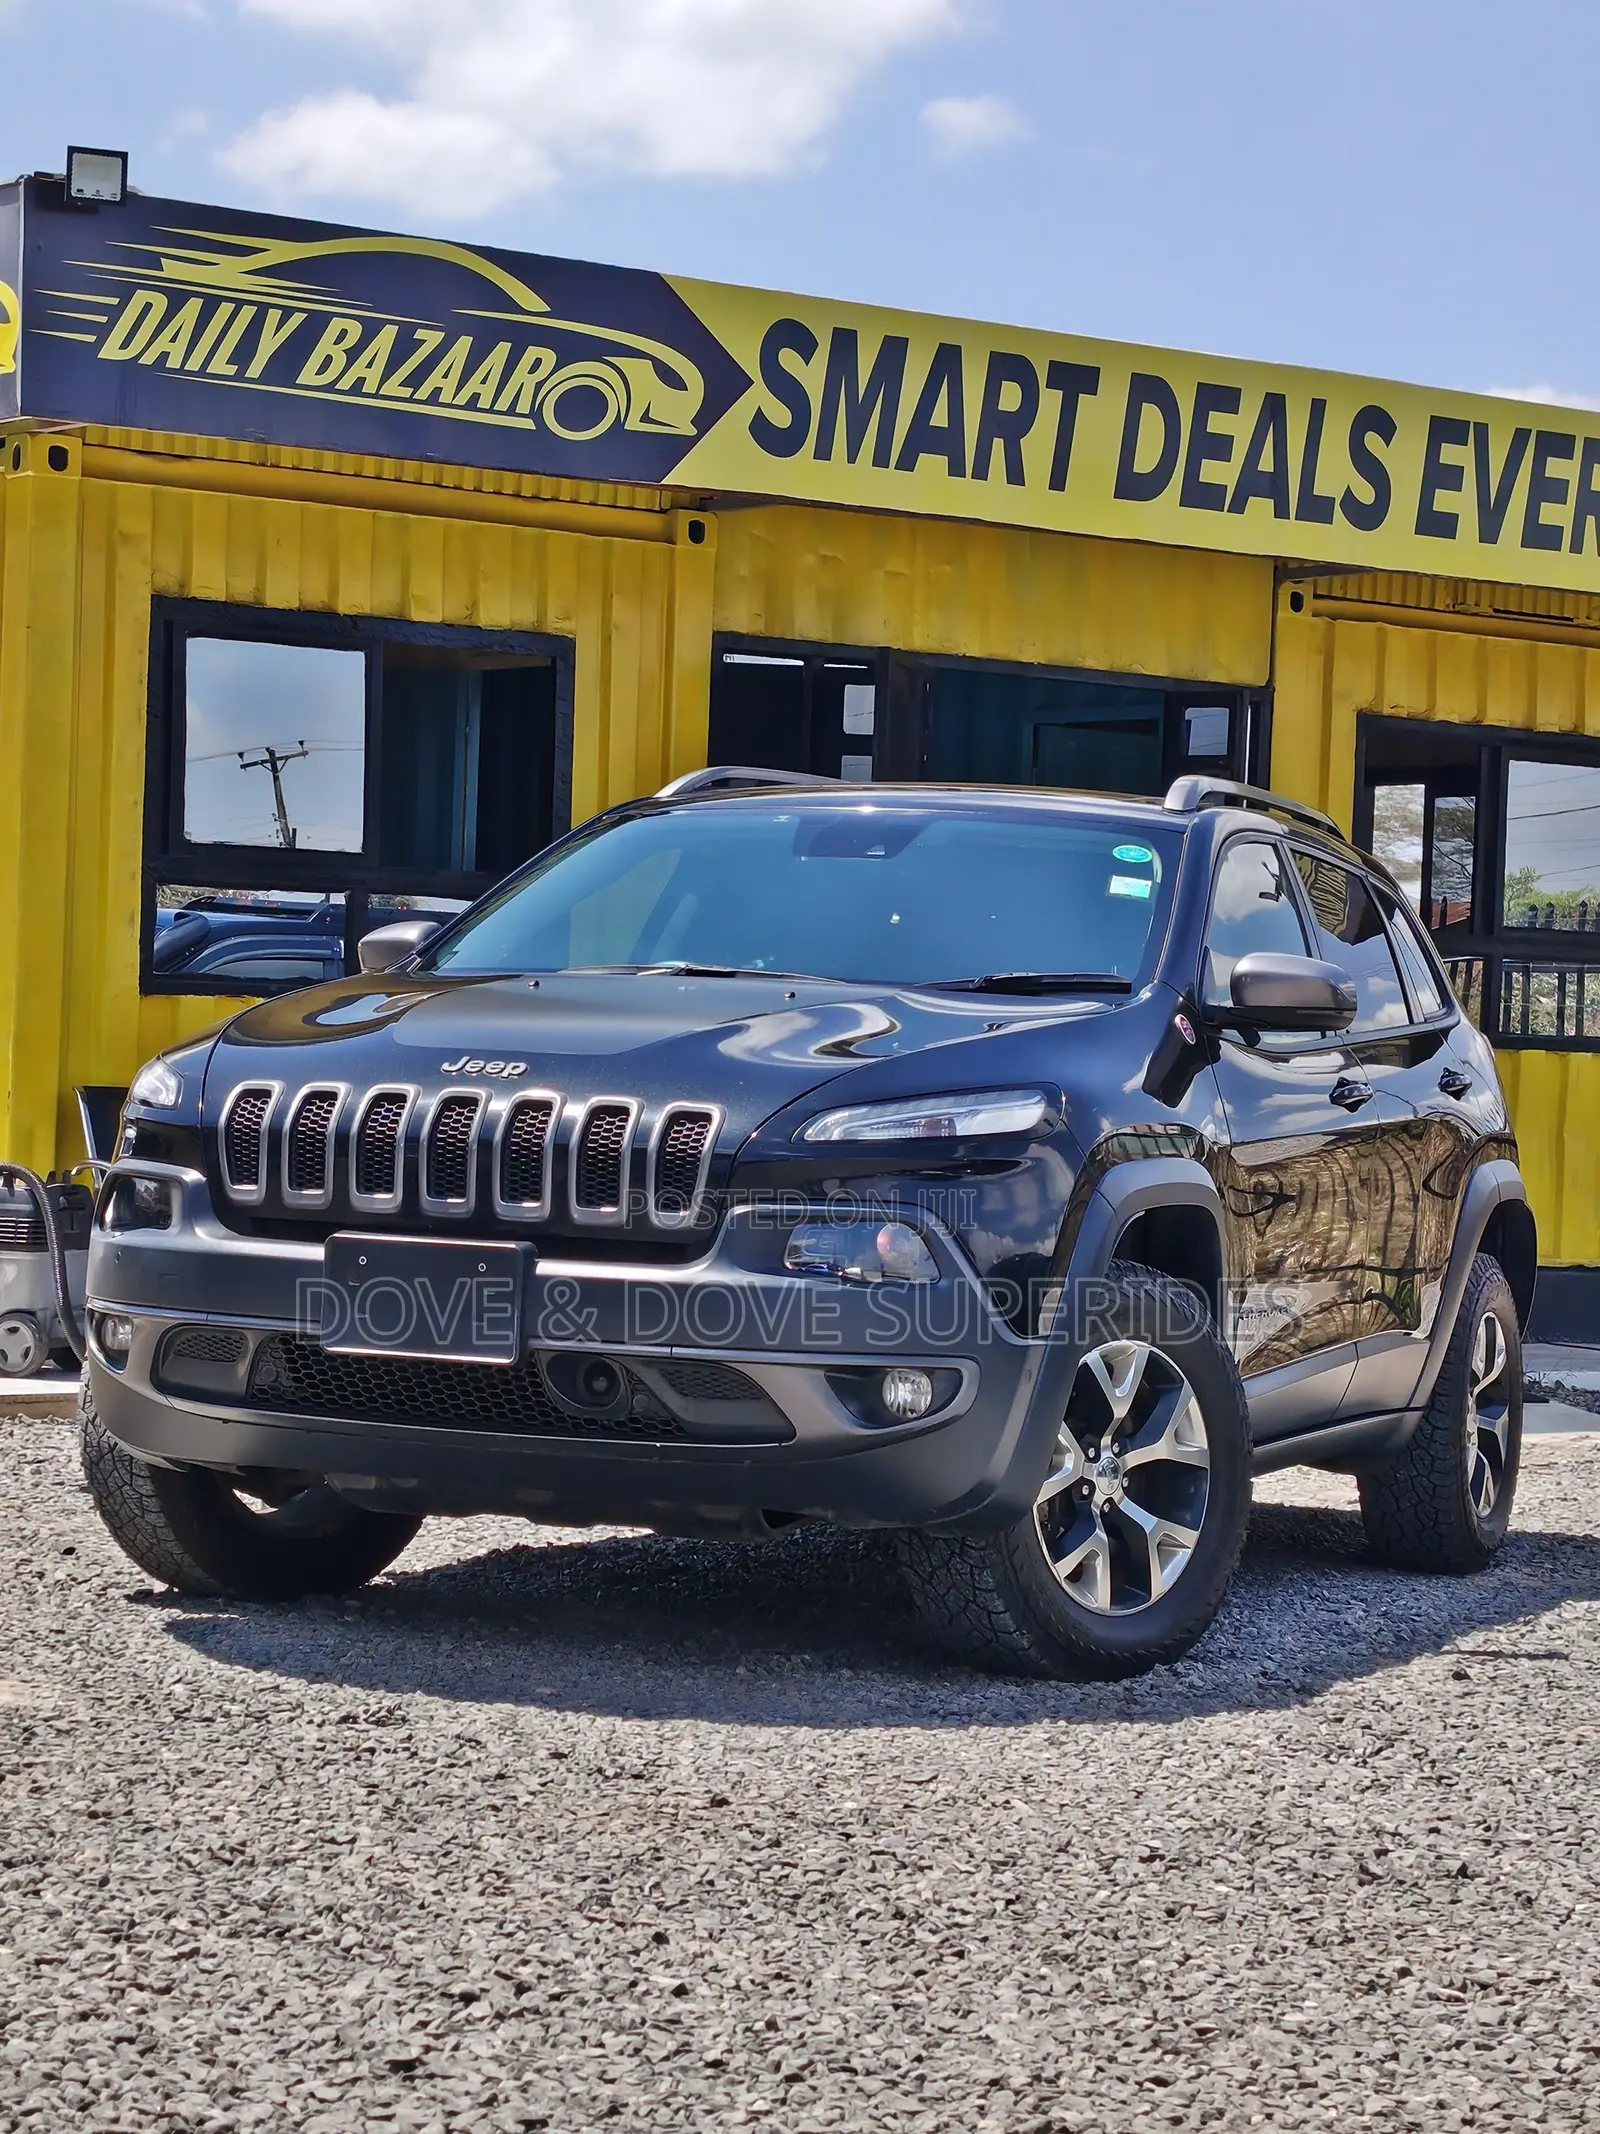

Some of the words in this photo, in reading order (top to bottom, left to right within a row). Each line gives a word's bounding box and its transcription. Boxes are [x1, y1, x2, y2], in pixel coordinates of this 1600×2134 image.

[98, 289, 306, 379] DAILY
[297, 317, 557, 415] BAZAAR
[748, 317, 1101, 492] SMART
[1113, 373, 1398, 532] DEALS
[441, 1055, 528, 1079] Jeep
